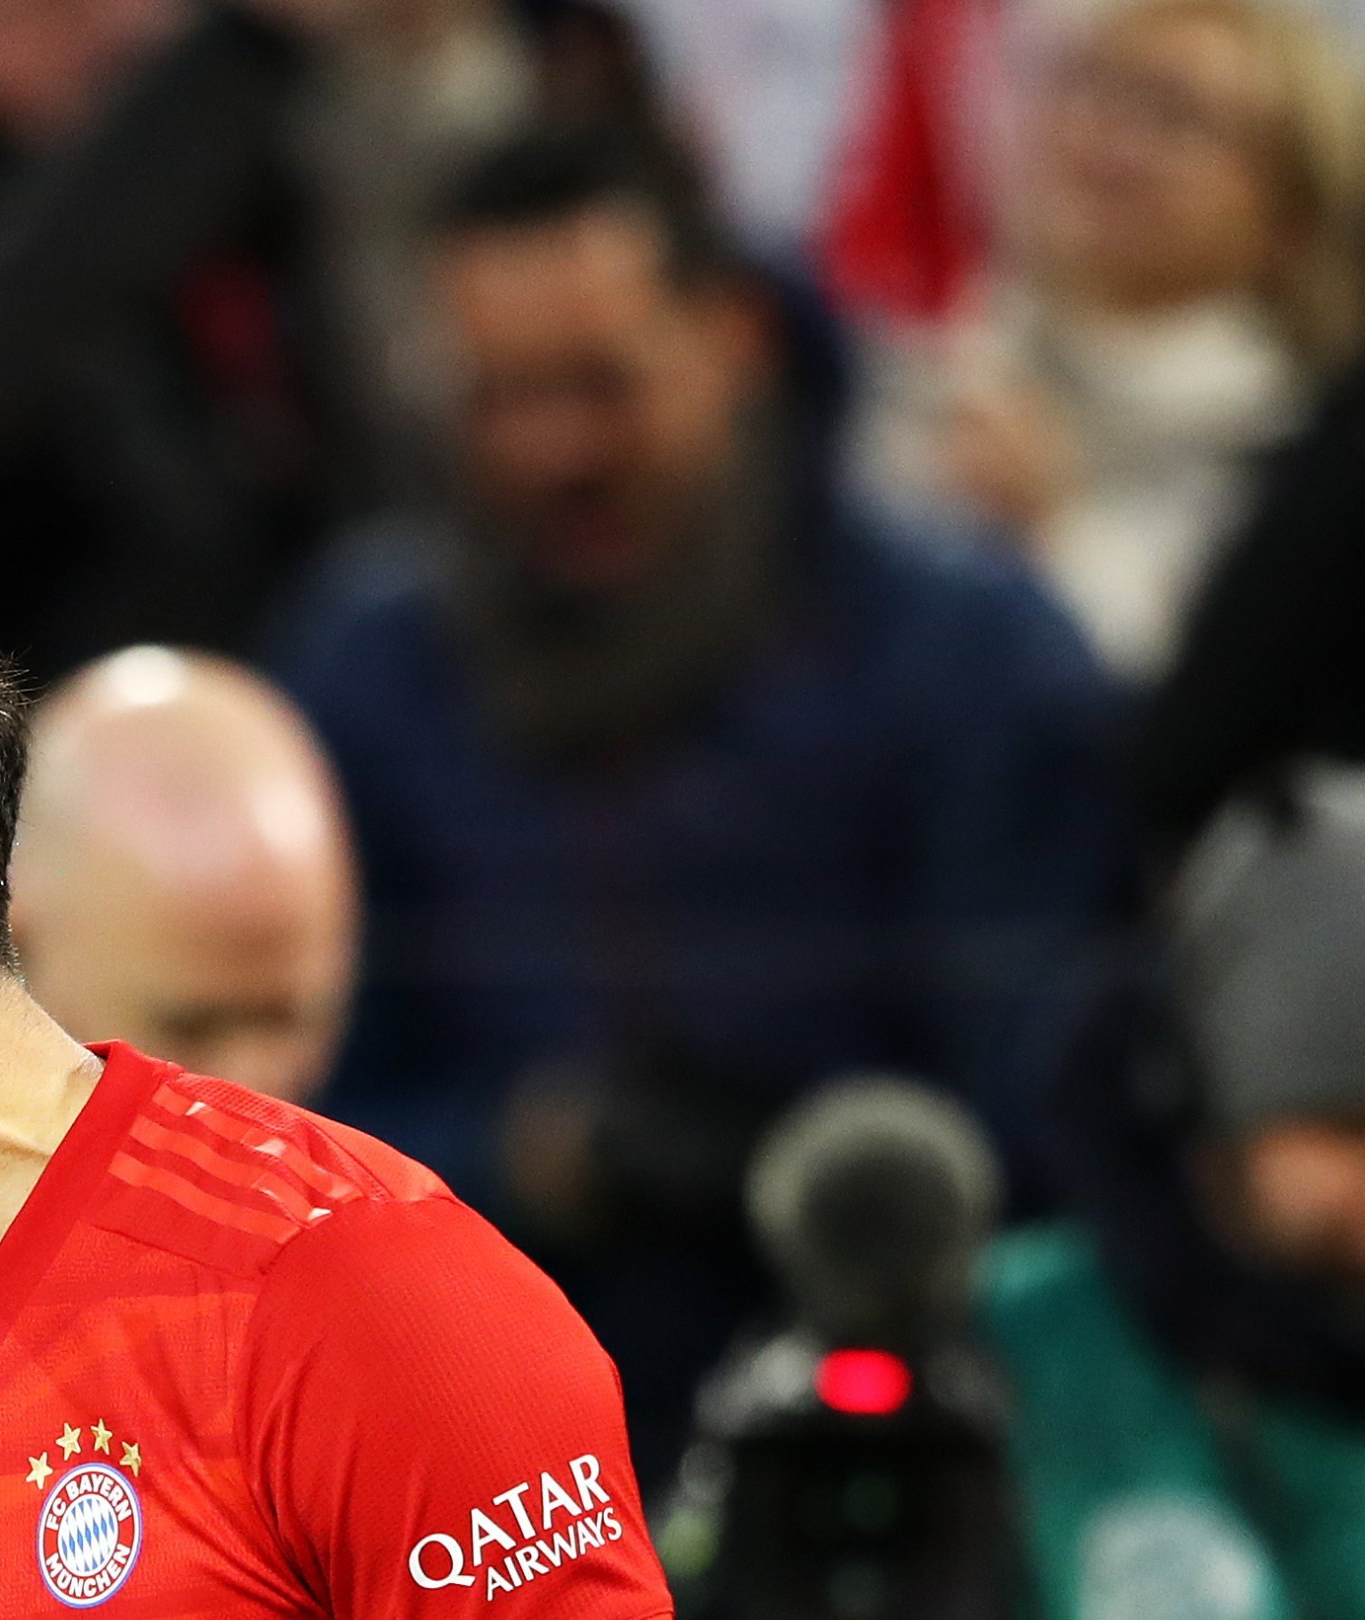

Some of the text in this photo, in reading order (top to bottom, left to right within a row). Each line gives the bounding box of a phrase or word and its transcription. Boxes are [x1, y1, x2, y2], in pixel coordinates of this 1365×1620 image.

[45, 1473, 133, 1531] FC BAYERN
[408, 1453, 611, 1589] QATAR
[486, 1506, 624, 1602] AIRWAYS
